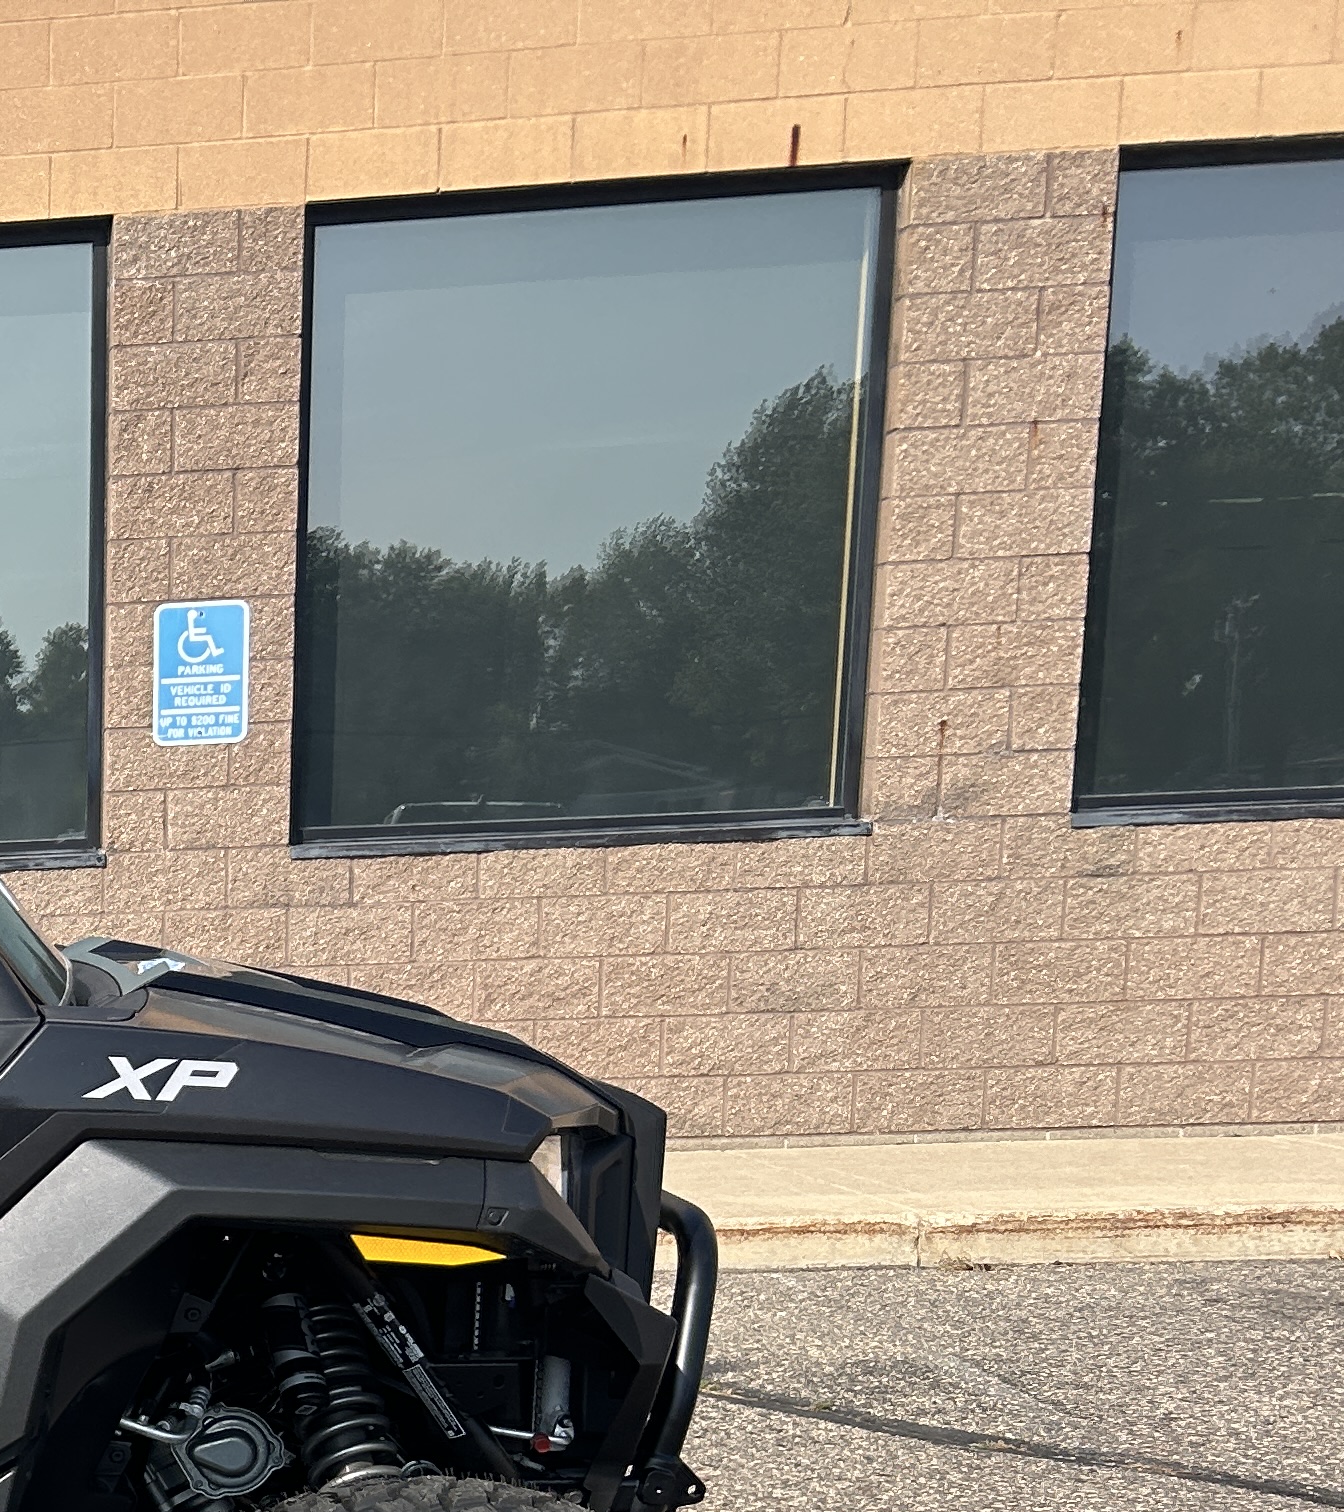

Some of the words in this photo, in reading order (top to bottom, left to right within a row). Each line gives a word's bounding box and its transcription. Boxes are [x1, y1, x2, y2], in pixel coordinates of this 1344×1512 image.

[177, 664, 224, 676] PARKING
[170, 684, 214, 696] VEHICLE
[220, 683, 232, 694] ID
[174, 695, 227, 707] REQUIRED
[160, 716, 173, 727] UP
[176, 715, 187, 726] TO
[191, 715, 215, 726] $200
[219, 713, 240, 725] FINE
[167, 728, 185, 739] FOR
[188, 726, 232, 738] VIOLATION
[81, 1056, 240, 1102] XP
